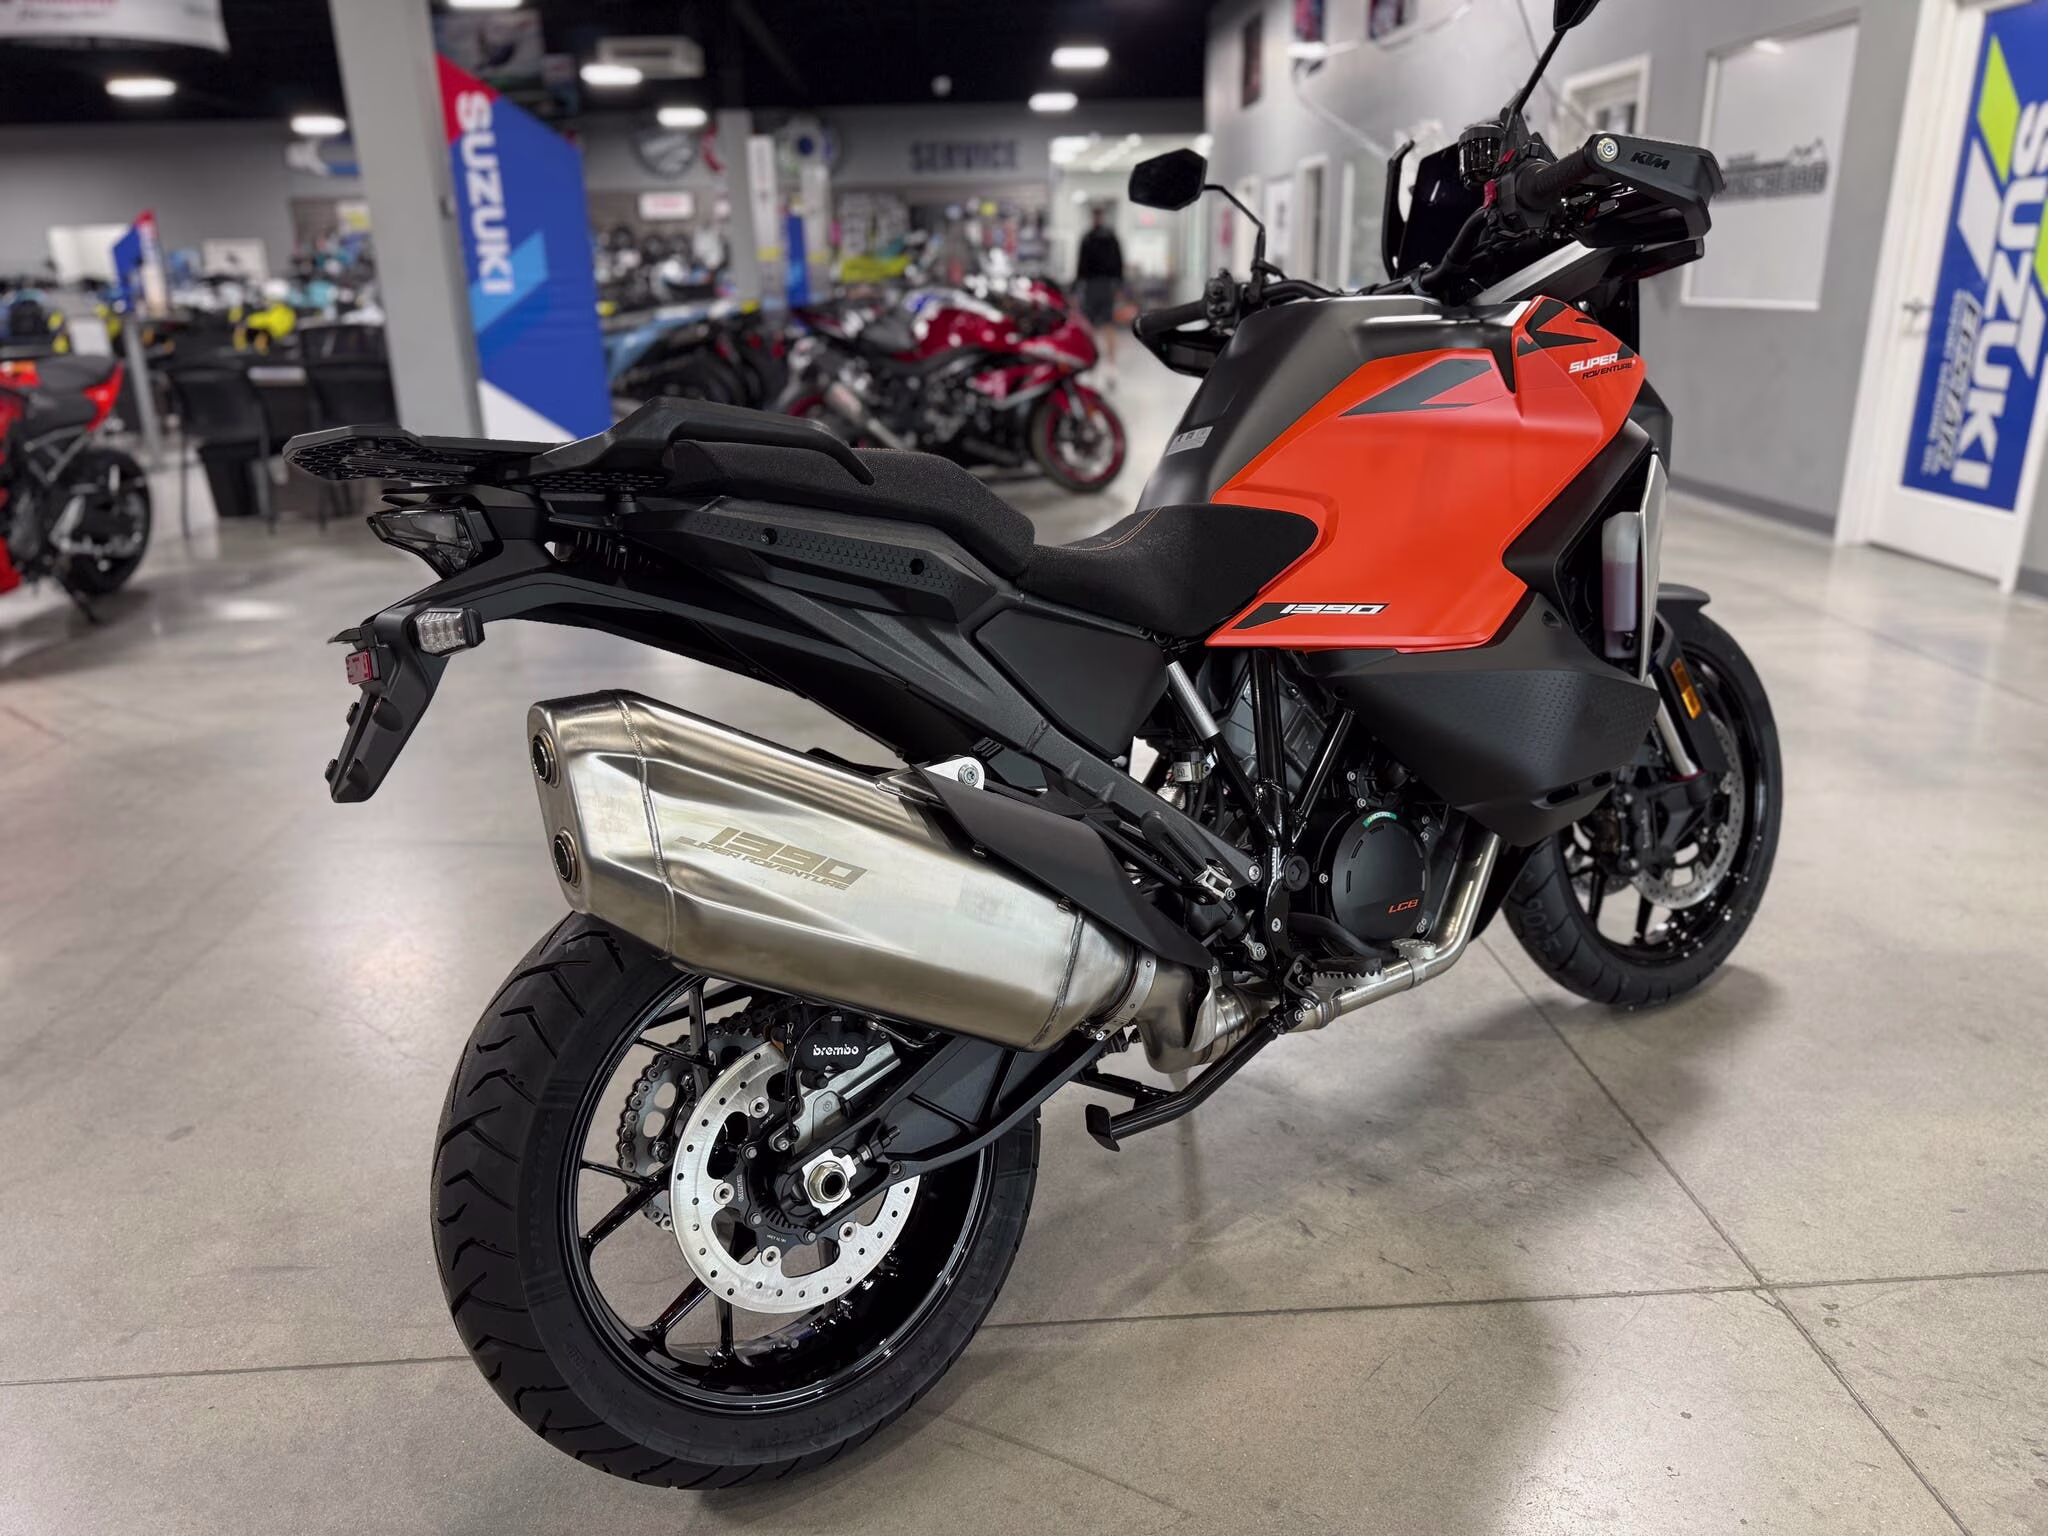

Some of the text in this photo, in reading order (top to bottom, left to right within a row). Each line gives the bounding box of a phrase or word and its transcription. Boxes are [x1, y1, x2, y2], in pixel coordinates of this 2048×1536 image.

[1630, 151, 1671, 170] KTM
[455, 90, 515, 294] SUZUKI
[1951, 100, 2048, 490] SUZUKI
[1568, 353, 1618, 374] SUPER
[1582, 362, 1633, 380] ADVENTURE
[1280, 603, 1385, 615] 1390
[674, 836, 851, 891] SUPER ADVENTURE
[708, 826, 868, 886] 1390
[813, 1043, 859, 1056] brembo
